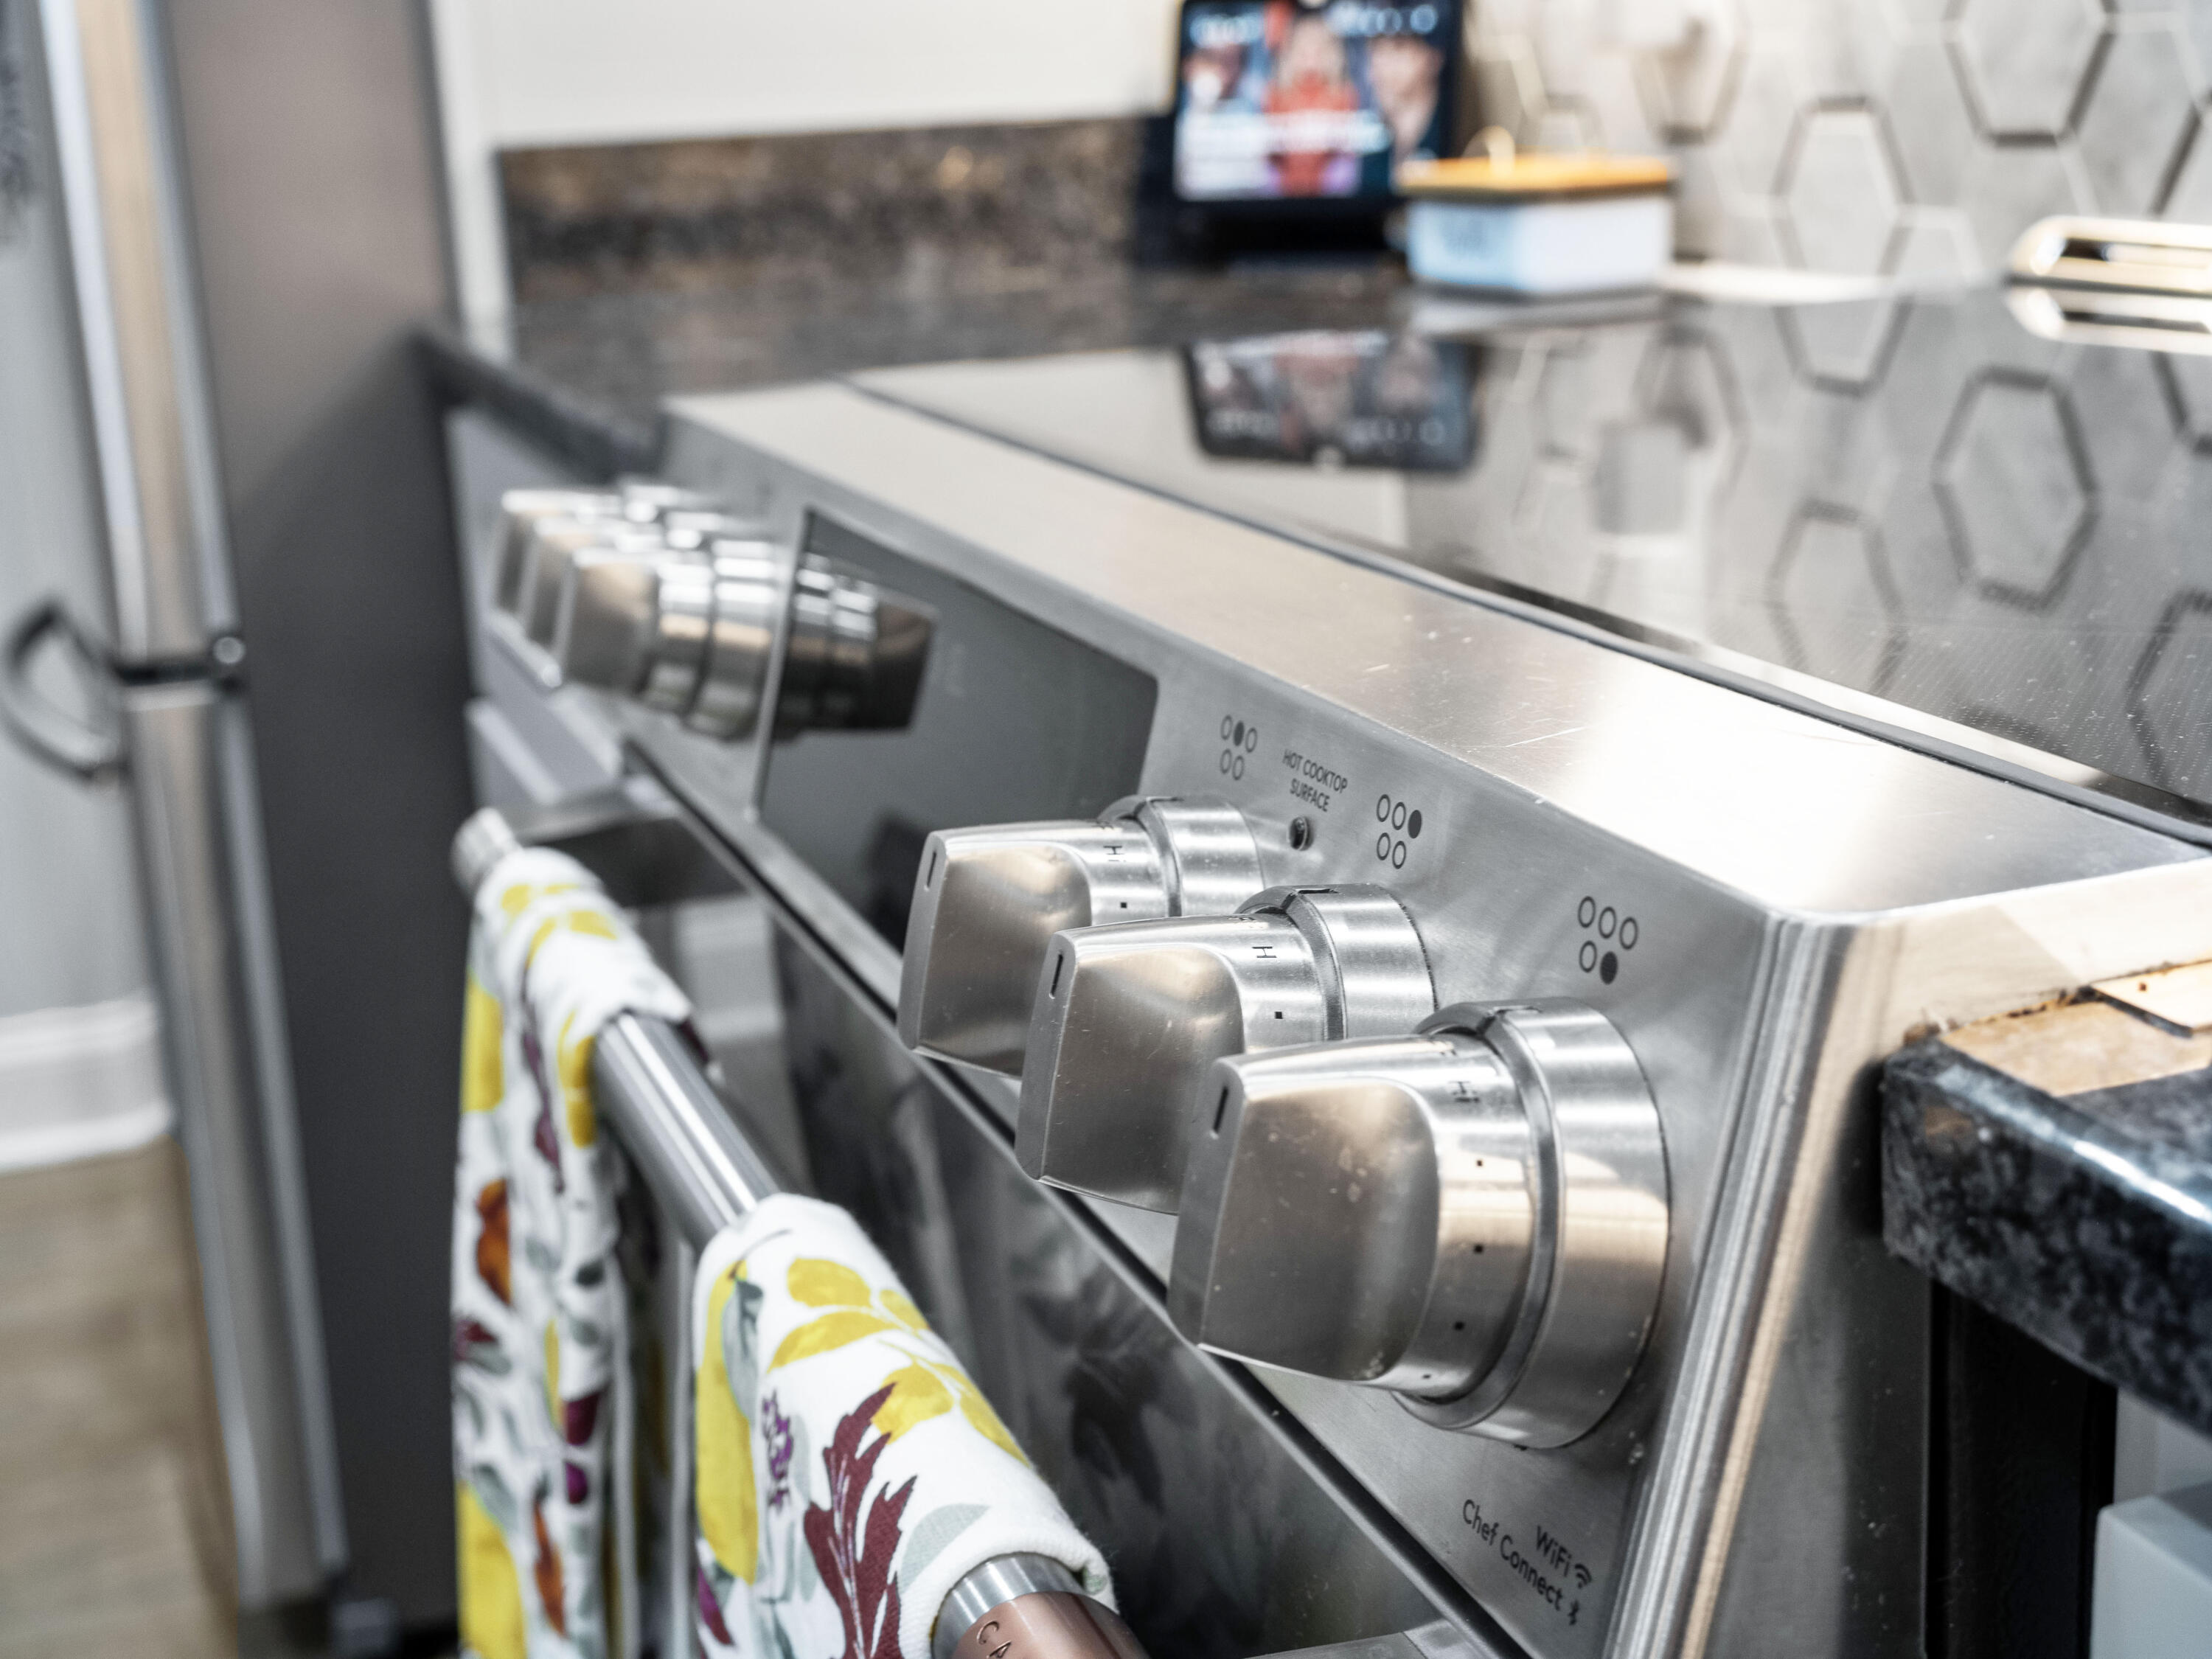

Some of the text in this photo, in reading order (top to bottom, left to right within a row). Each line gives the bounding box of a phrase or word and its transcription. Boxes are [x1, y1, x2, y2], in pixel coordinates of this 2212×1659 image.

[1282, 749, 1348, 793] HOT COOKTOP
[1290, 778, 1330, 812] SURFACE
[1463, 1499, 1563, 1611] Chef Connect
[1536, 1525, 1572, 1578] WiFi
